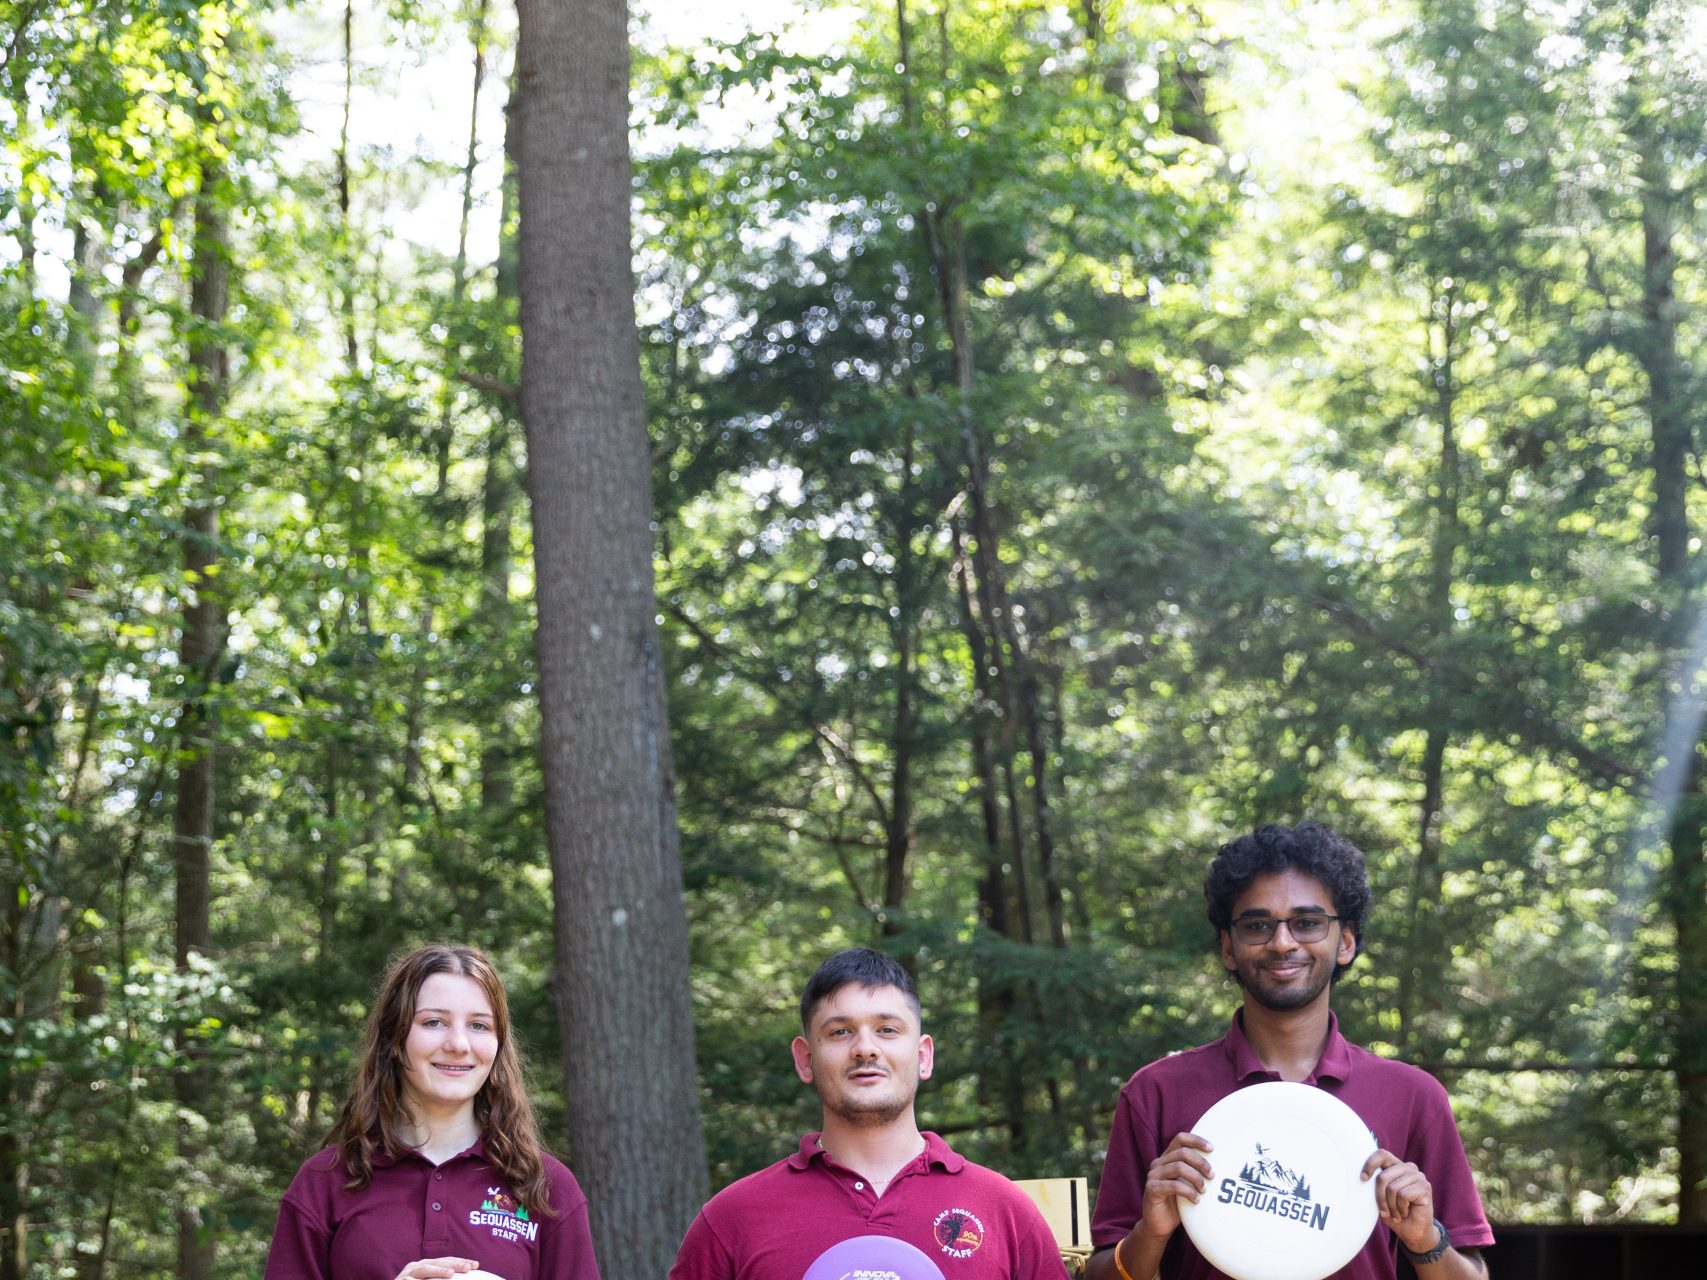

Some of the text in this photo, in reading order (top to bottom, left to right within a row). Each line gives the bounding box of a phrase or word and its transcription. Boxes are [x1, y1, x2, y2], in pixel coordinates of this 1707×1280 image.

[1217, 1178, 1330, 1231] SEQUASSEN
[469, 1210, 539, 1241] SEQUASSEN
[492, 1228, 518, 1242] STAFF
[941, 1245, 972, 1258] STAFF
[853, 1270, 896, 1278] INNOVA
